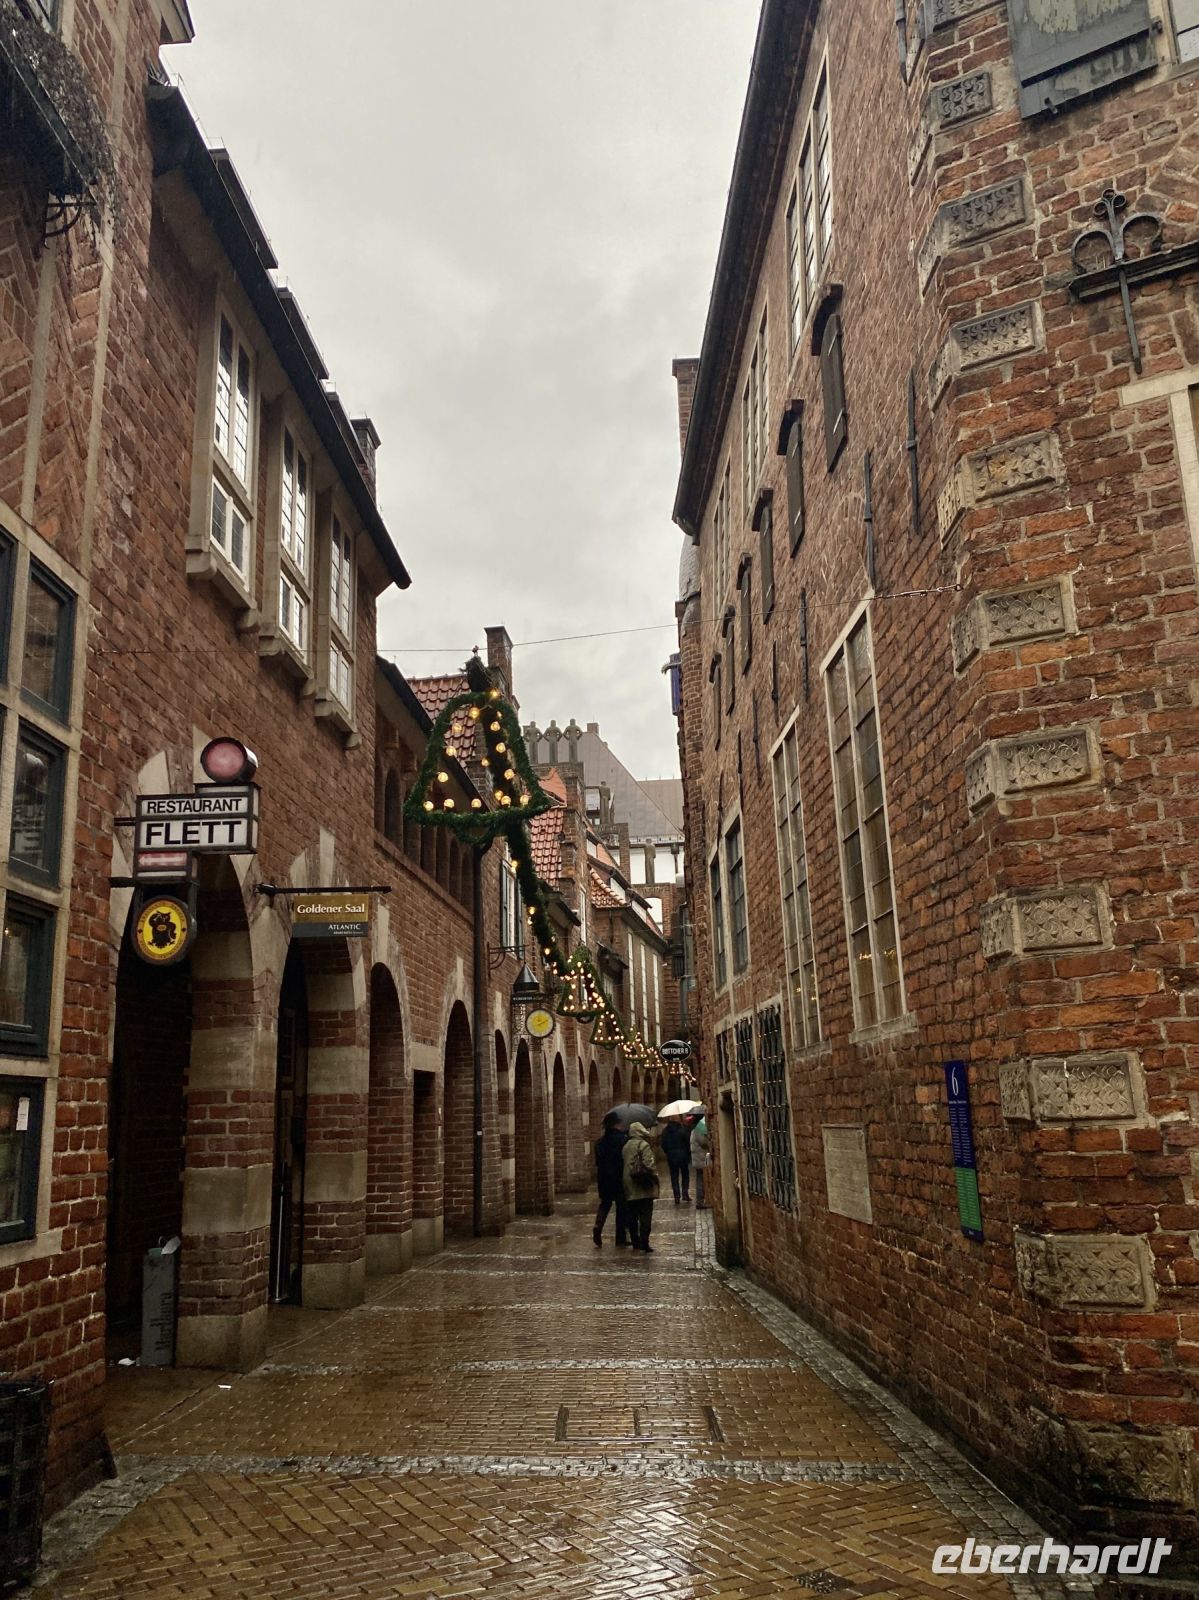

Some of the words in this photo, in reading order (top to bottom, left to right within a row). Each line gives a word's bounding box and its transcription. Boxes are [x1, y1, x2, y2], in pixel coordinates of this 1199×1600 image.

[147, 799, 241, 814] RESTAURANT
[146, 821, 241, 846] FLETT
[297, 904, 342, 914] Goldener
[345, 903, 365, 913] Saal
[952, 1067, 959, 1096] 6
